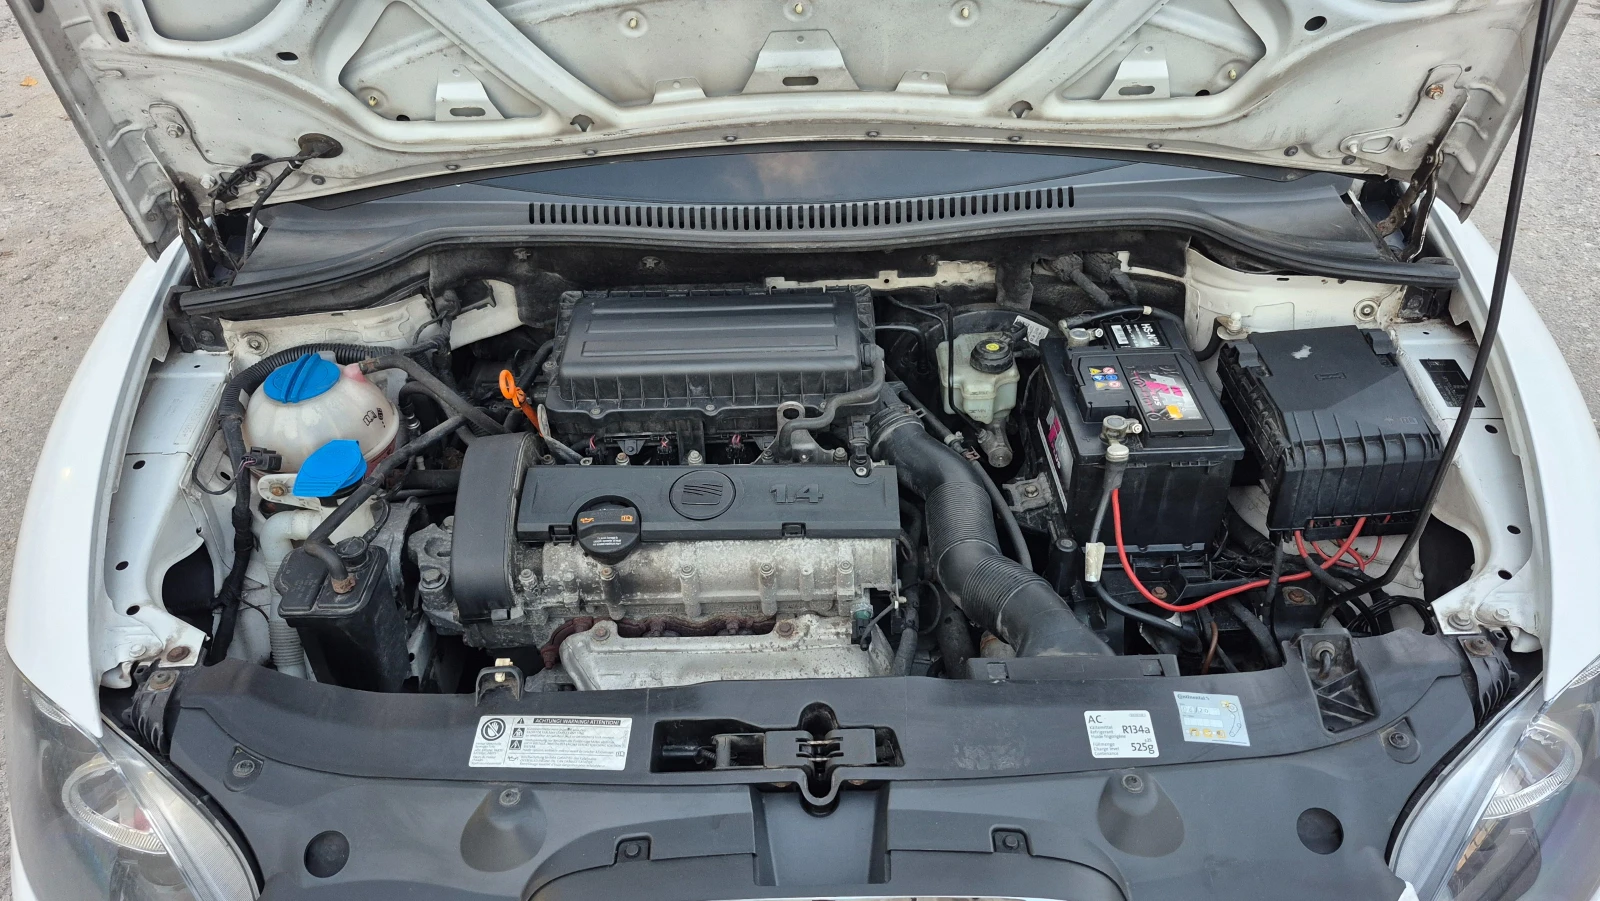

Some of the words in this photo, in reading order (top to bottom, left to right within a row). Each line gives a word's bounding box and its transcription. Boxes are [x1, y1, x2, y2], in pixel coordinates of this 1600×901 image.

[1088, 715, 1103, 724] AC
[1122, 725, 1151, 734] R134a
[1131, 742, 1155, 755] 525g
